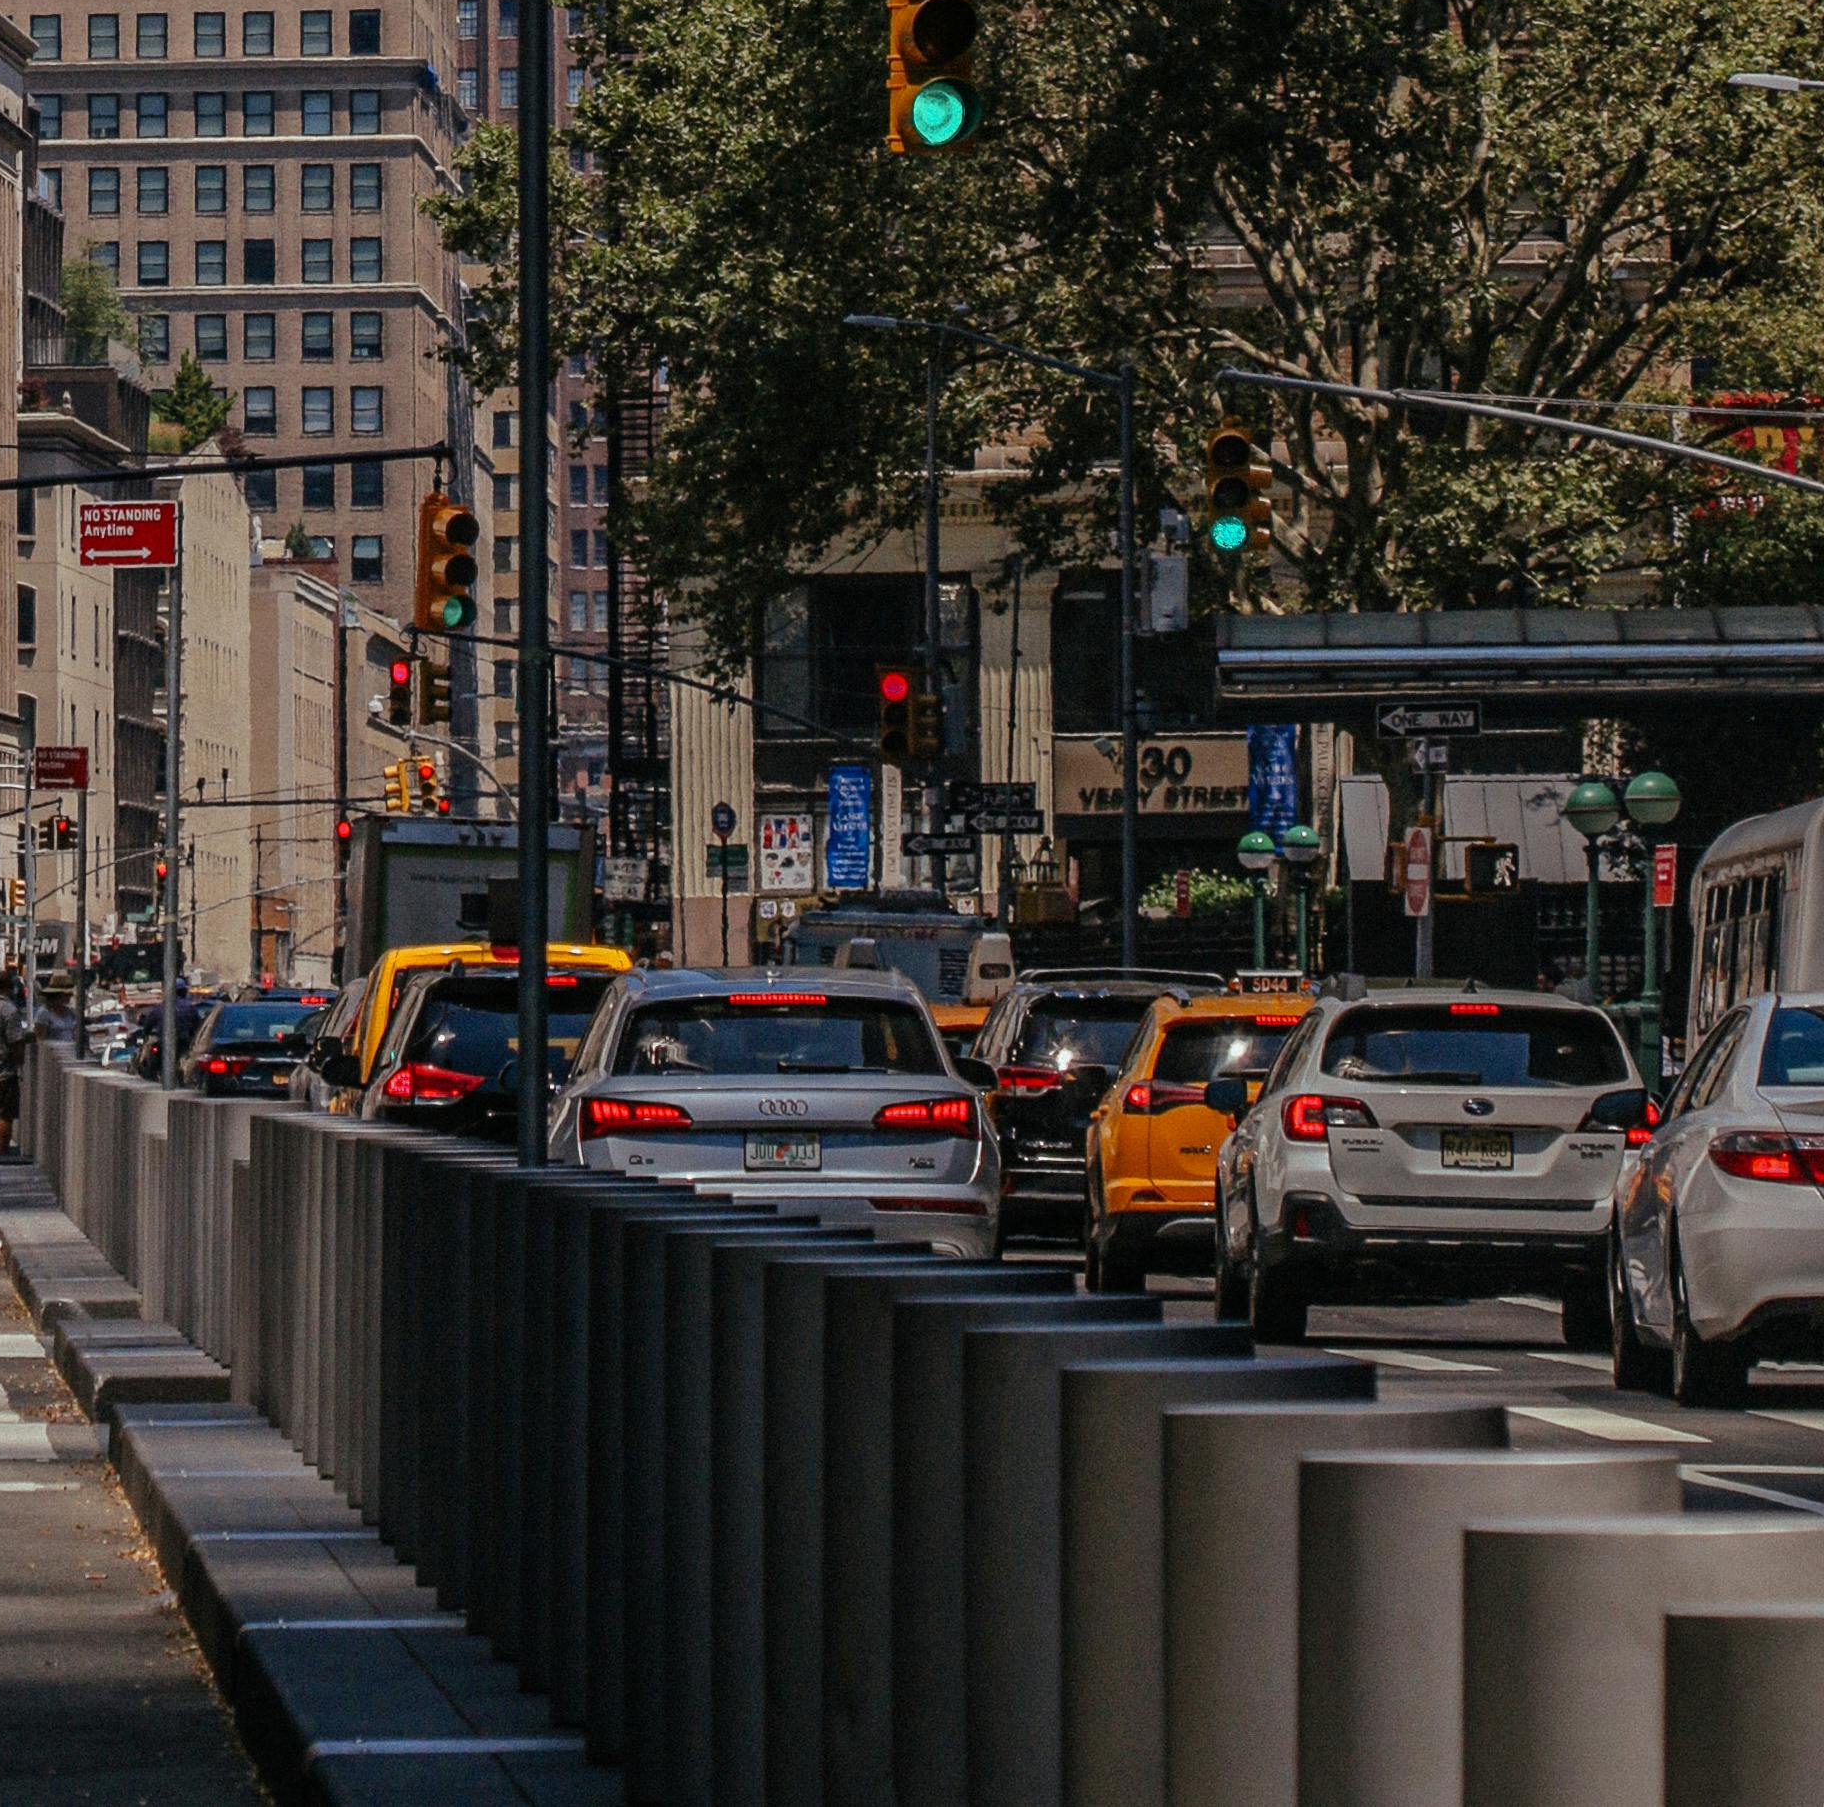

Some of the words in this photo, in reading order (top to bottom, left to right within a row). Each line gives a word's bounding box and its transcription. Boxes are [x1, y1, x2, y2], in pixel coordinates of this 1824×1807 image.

[84, 509, 100, 522] NO
[103, 508, 162, 522] STANDING
[84, 524, 134, 539] Anytime
[1391, 714, 1422, 728] ONE
[1438, 712, 1470, 726] WAY
[1139, 746, 1193, 789] 30
[1163, 785, 1249, 809] STREET
[1252, 978, 1288, 992] 5D44
